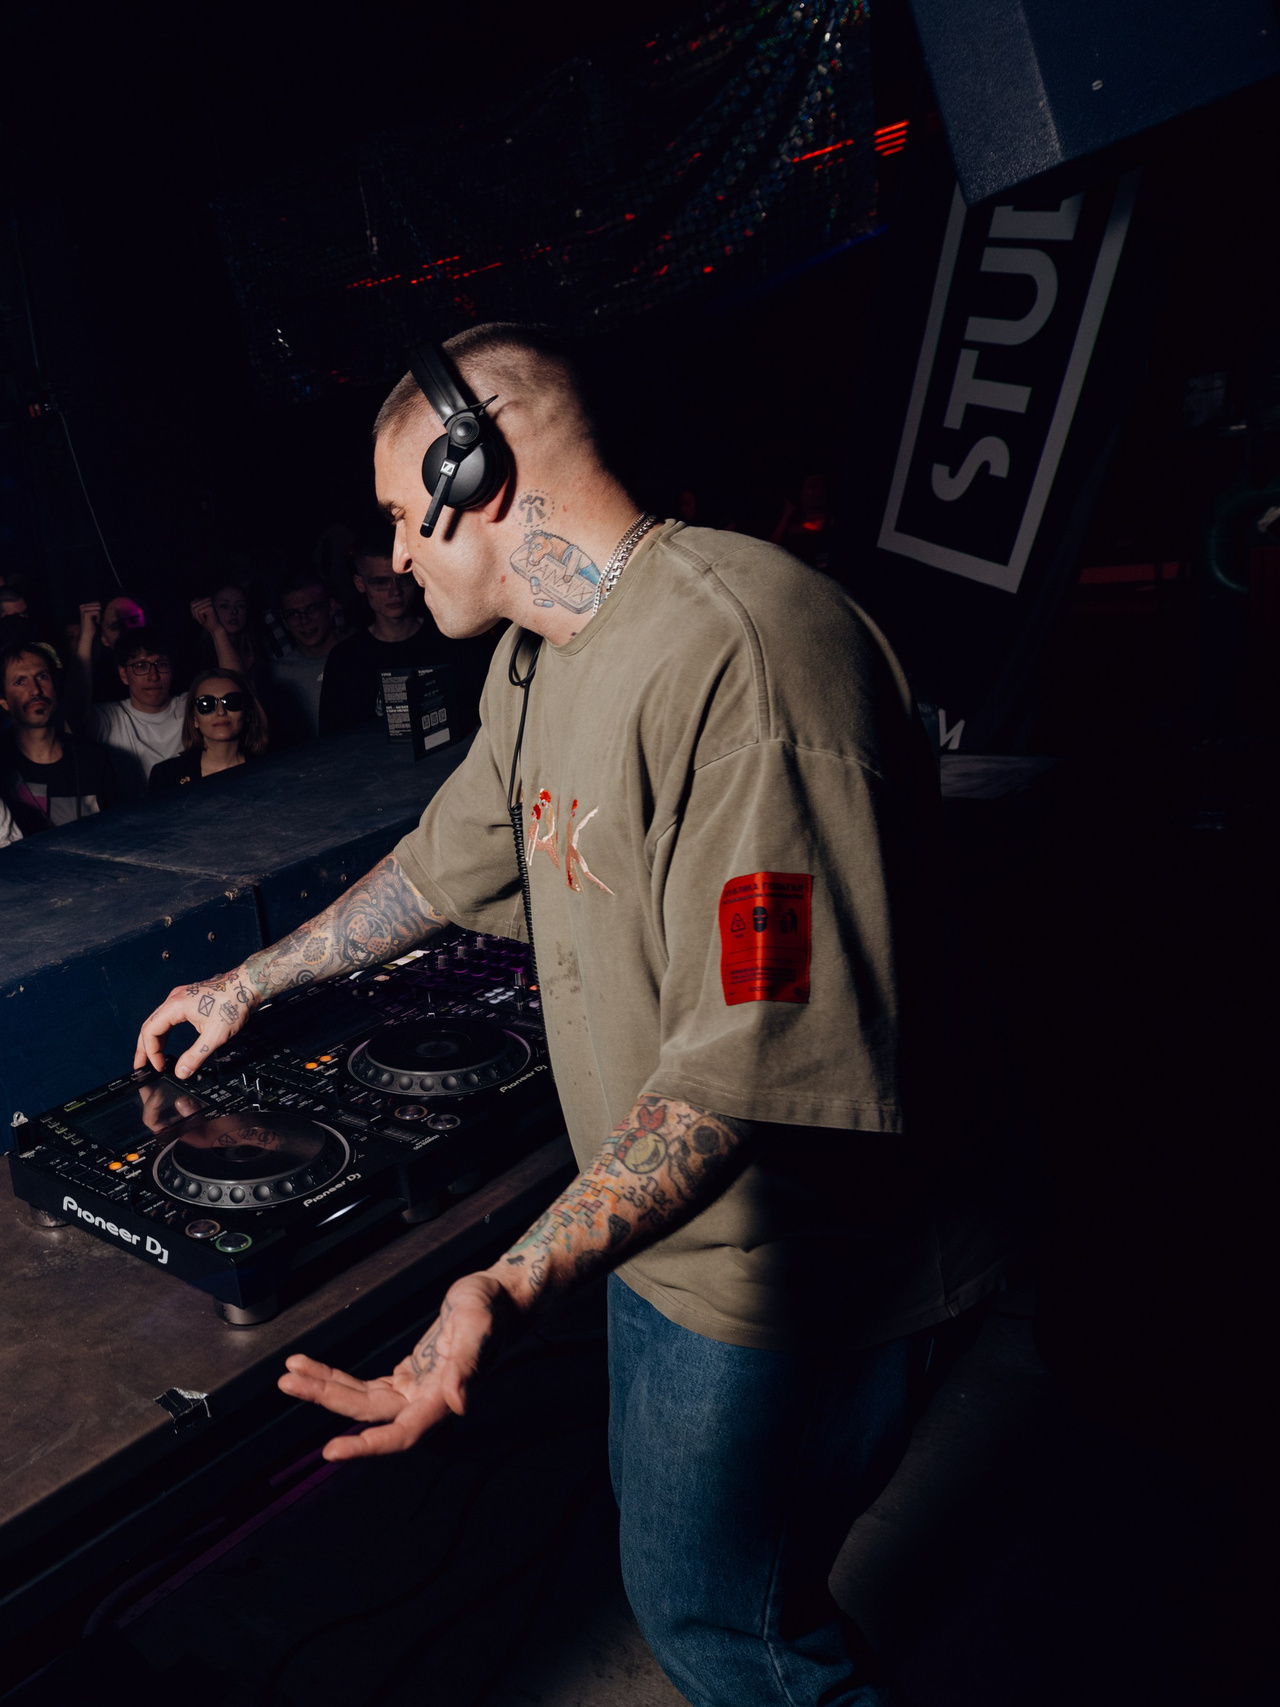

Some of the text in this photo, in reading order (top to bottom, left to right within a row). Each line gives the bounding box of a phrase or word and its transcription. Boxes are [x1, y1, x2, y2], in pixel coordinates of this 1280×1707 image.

[499, 1071, 535, 1093] Pioneer
[303, 1180, 347, 1208] Pioneer
[62, 1195, 141, 1245] Pioneer
